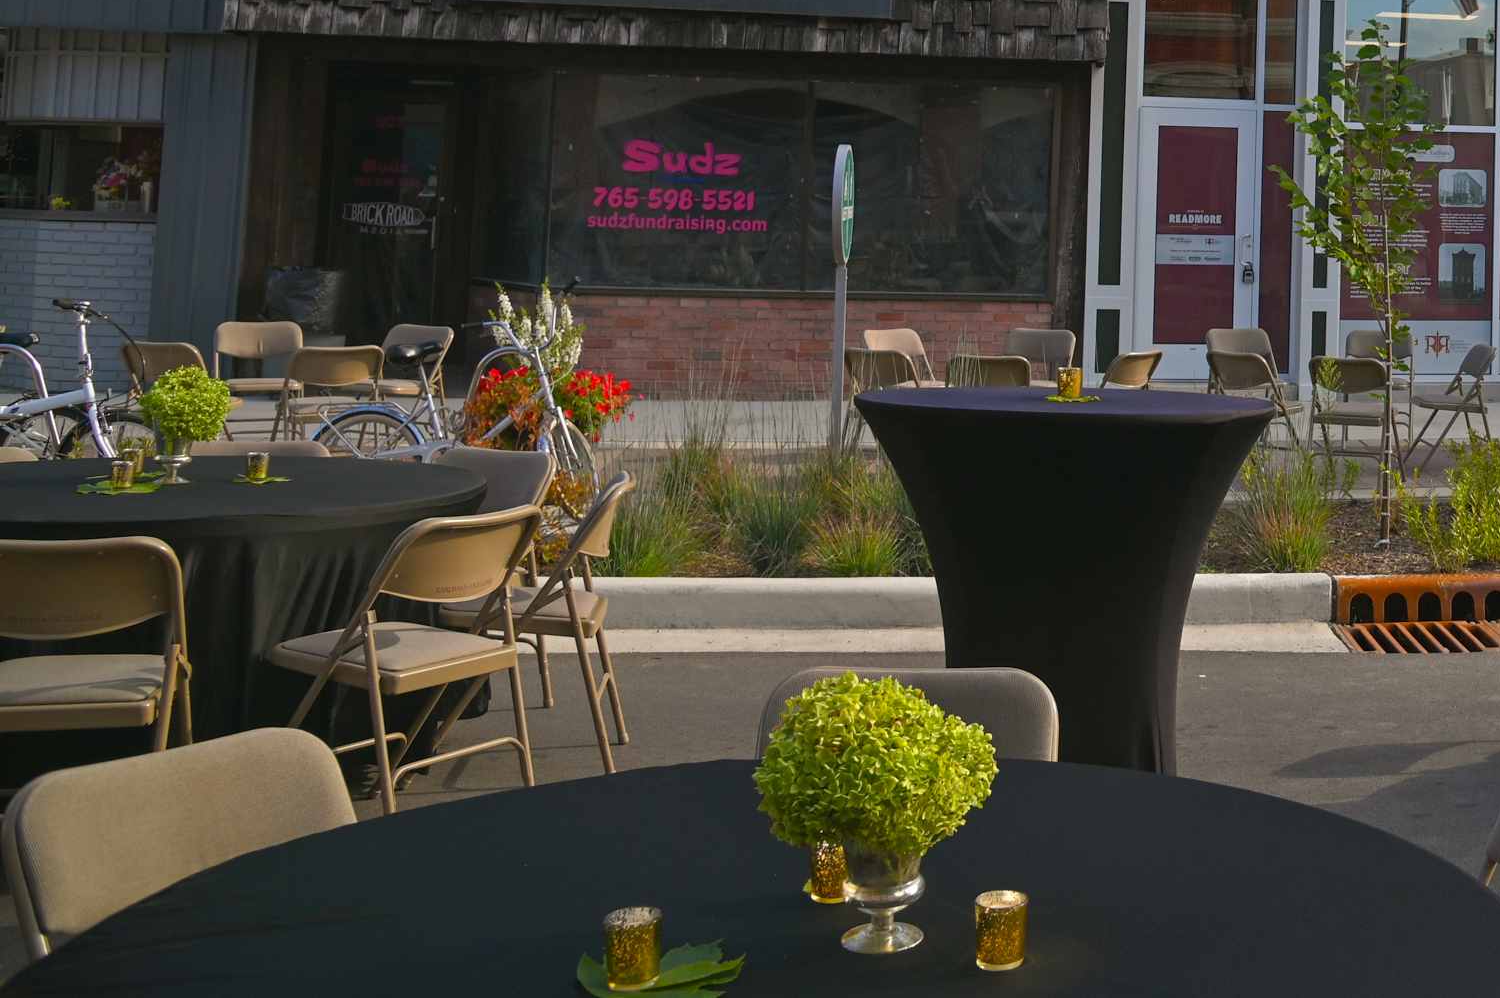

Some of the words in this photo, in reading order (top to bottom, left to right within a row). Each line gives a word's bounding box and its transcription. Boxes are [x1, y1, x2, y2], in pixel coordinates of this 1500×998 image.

[622, 139, 741, 175] Sudz
[593, 187, 755, 211] 765-598-5521
[351, 204, 385, 225] BRICK
[386, 204, 414, 225] ROAD
[1169, 214, 1222, 224] READMORE
[359, 226, 403, 235] MEDIA
[587, 212, 768, 234] sudzfundraising.com
[436, 584, 466, 593] EARLHAM
[0, 615, 41, 623] EARLHAM
[50, 613, 103, 622] EXCELLENCE
